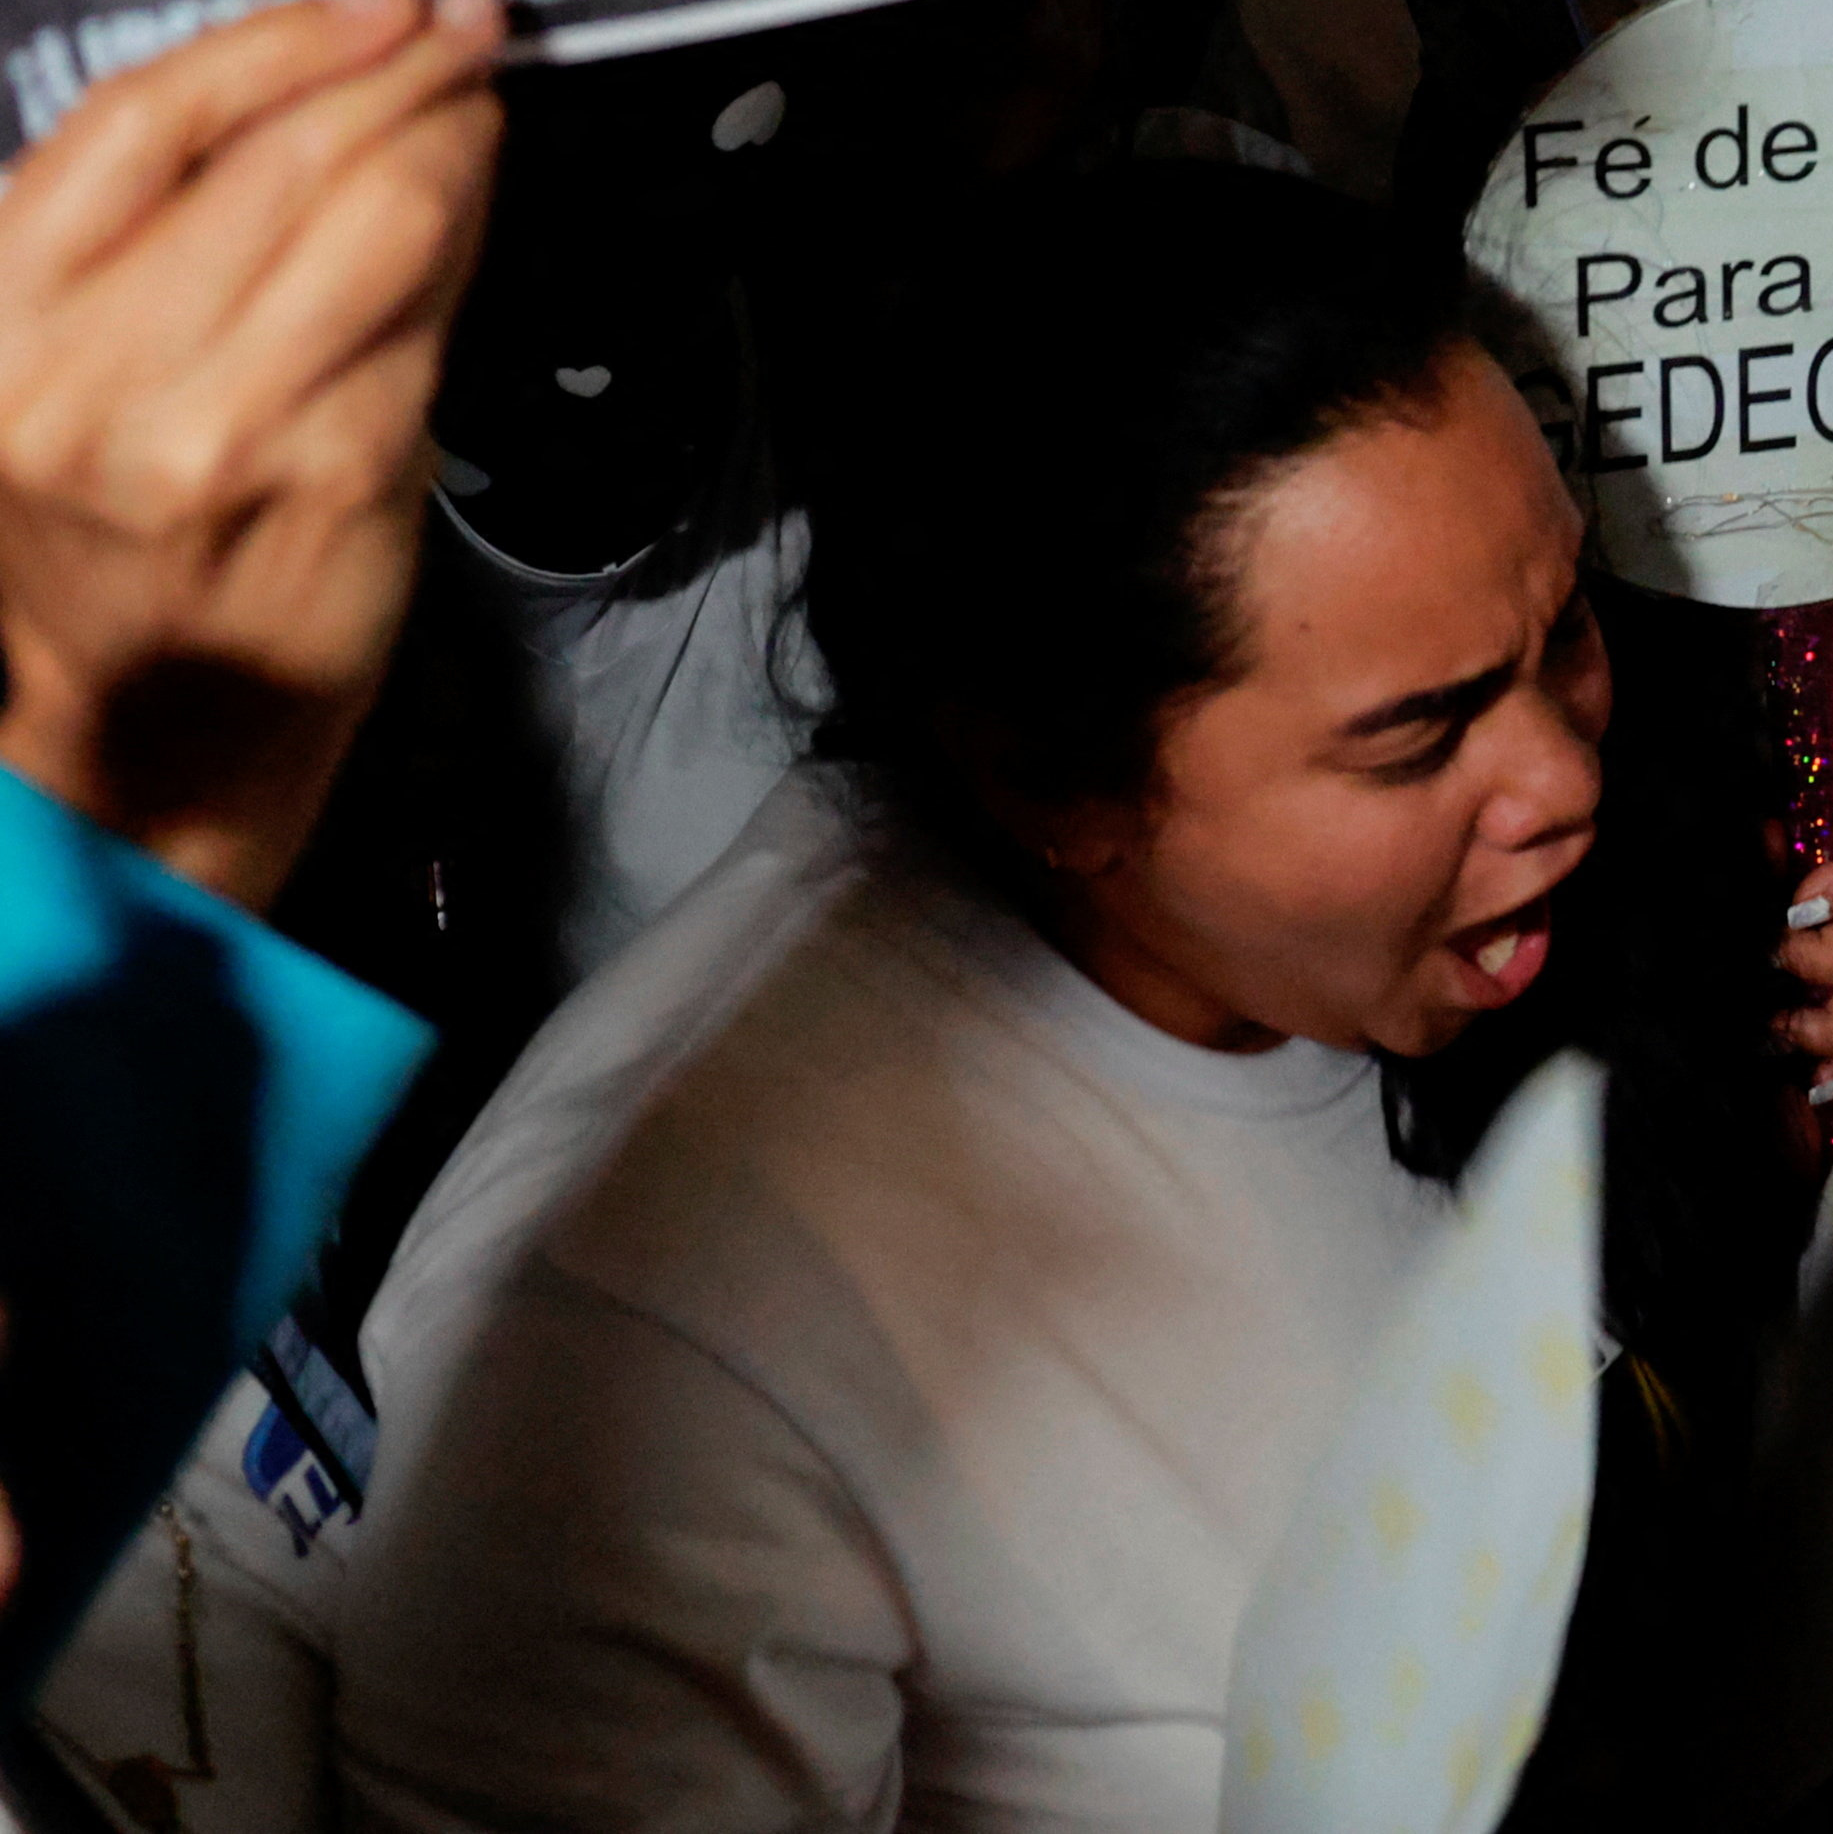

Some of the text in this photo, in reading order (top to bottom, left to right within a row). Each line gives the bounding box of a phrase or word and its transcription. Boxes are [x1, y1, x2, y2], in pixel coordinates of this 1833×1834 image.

[1521, 114, 1653, 208] Fé
[1694, 104, 1818, 190] de
[1576, 252, 1813, 337] Para
